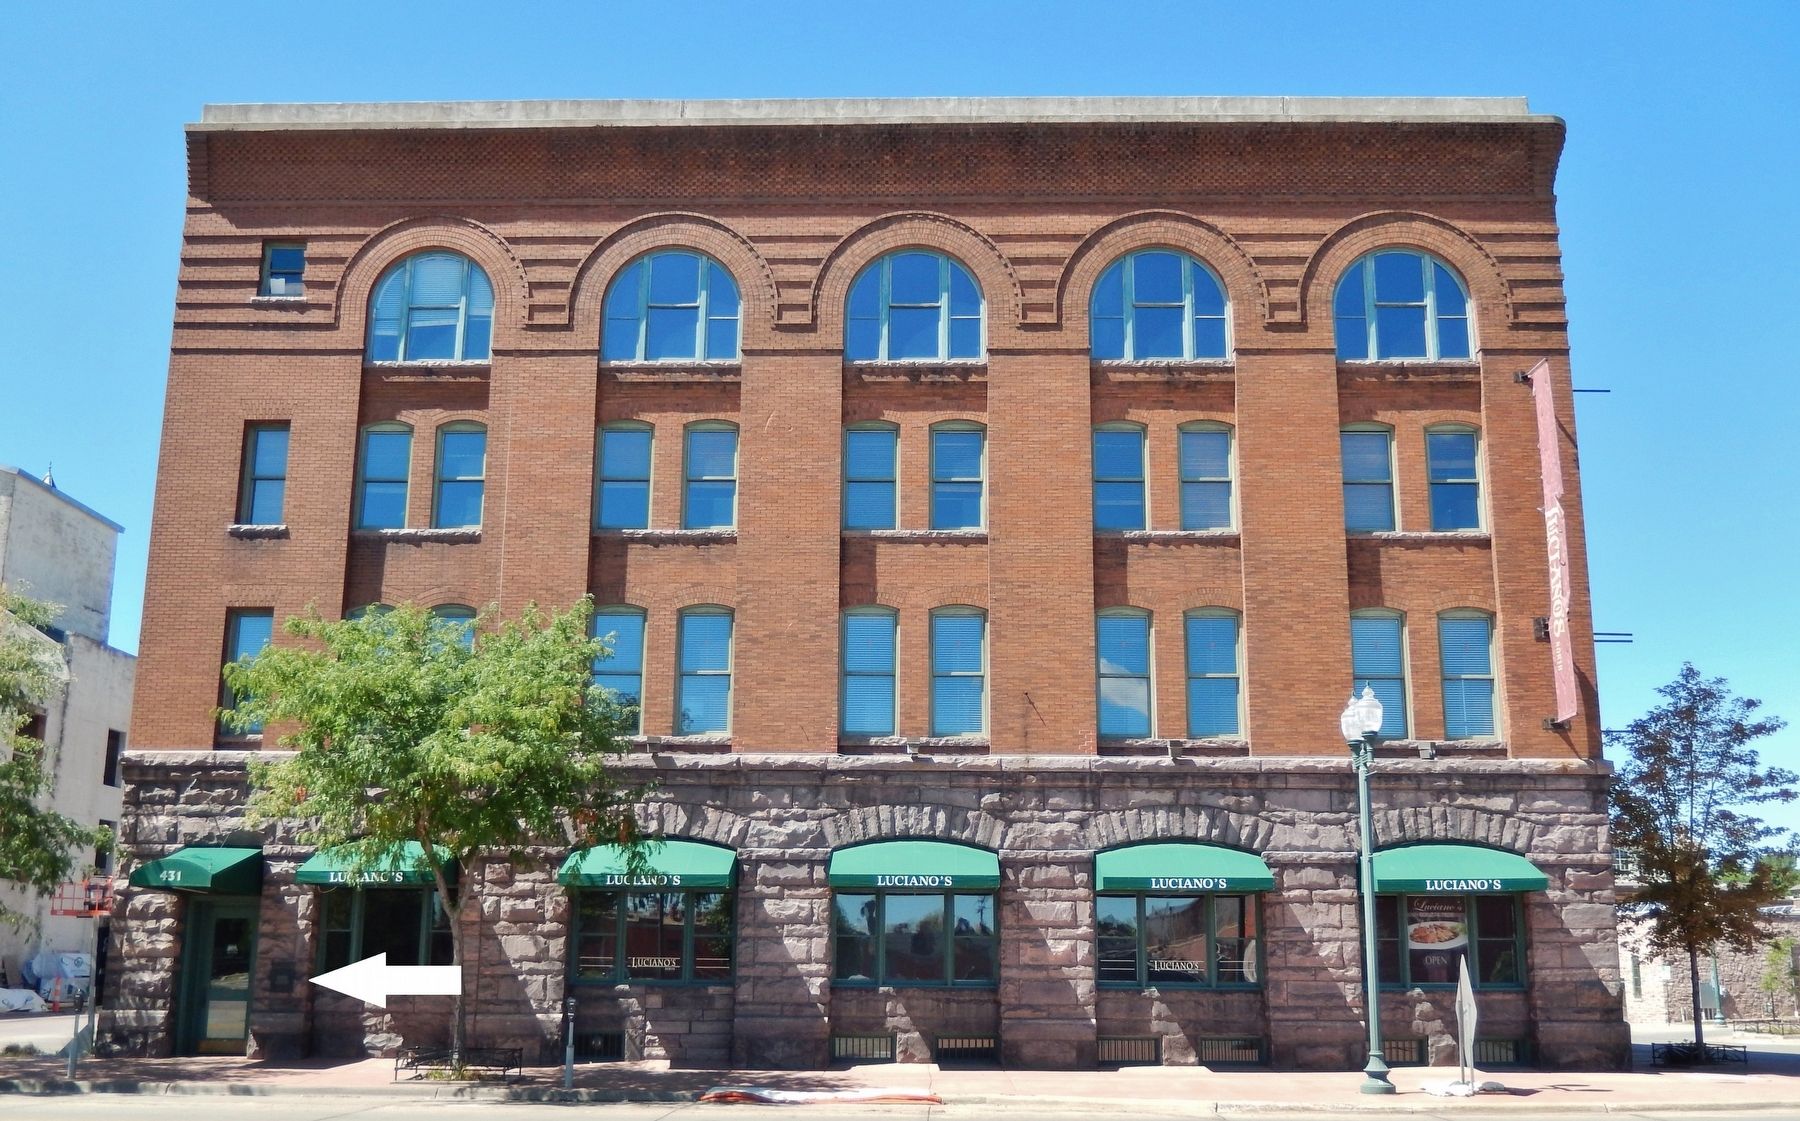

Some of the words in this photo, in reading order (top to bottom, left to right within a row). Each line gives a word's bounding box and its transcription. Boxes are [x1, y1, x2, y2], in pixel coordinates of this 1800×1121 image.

[160, 870, 182, 881] 431
[877, 875, 953, 886] LUCIANO'S
[1151, 878, 1227, 889] LUCIANO'S
[1425, 879, 1502, 890] LUCIANO'S
[632, 957, 676, 968] LUCIANO'S
[1154, 960, 1199, 971] LUCIANO'S
[1424, 956, 1448, 966] OPEN
